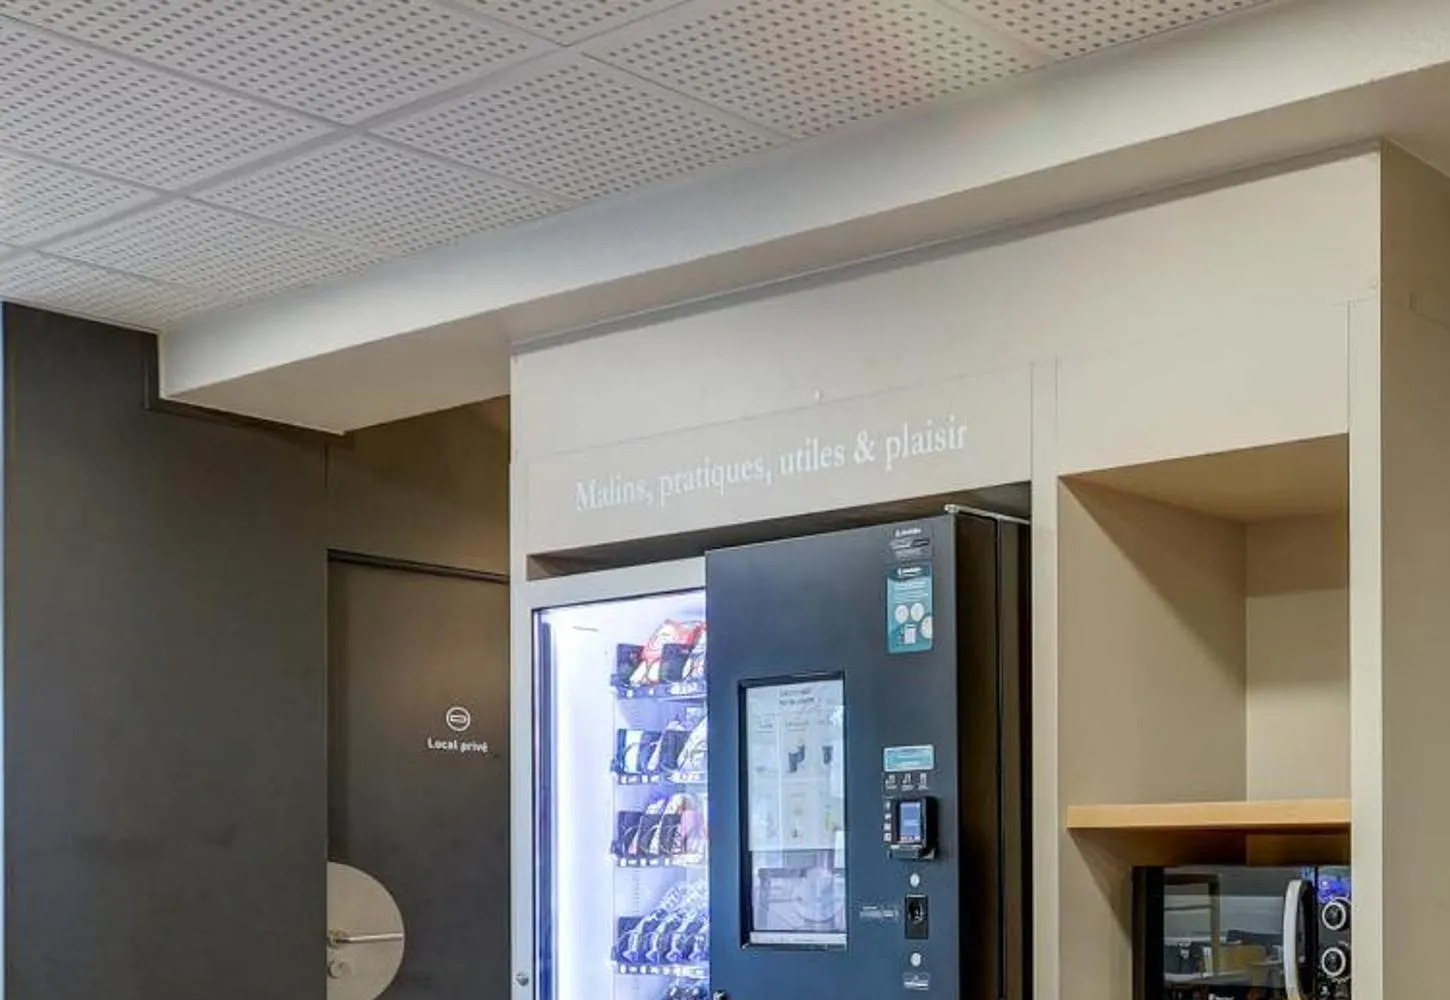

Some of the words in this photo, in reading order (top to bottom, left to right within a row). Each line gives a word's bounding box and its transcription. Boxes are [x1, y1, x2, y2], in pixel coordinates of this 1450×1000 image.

[575, 478, 654, 511] Malins,
[658, 455, 773, 508] pratiques,
[779, 436, 846, 475] utiles
[853, 427, 876, 464] &
[885, 412, 968, 471] plaisir
[427, 736, 458, 750] Local
